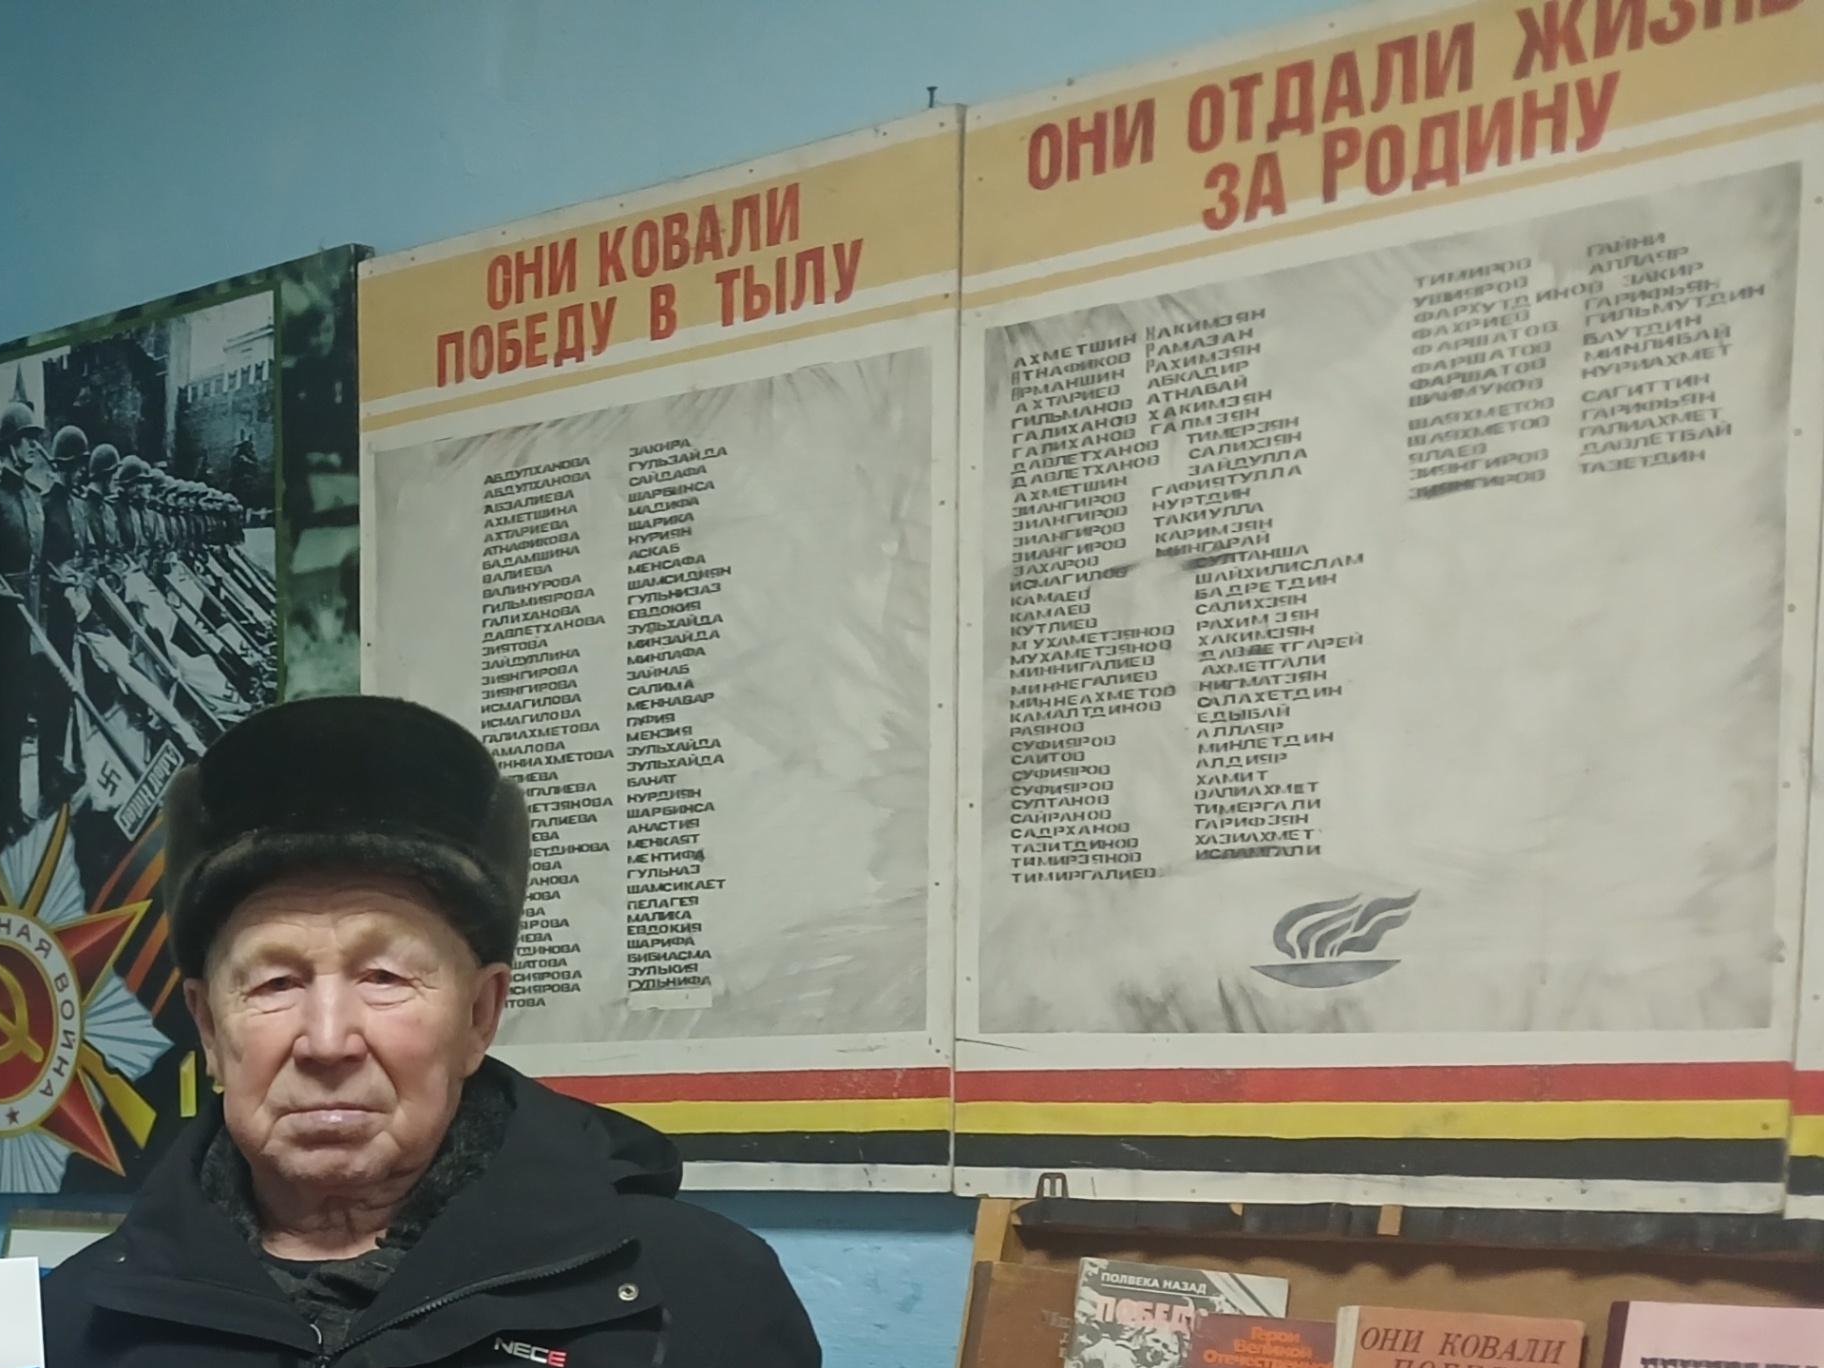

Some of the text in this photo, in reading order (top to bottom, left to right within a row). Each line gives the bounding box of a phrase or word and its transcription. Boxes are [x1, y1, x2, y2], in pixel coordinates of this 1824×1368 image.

[1028, 0, 1806, 191] ОНИ ОТДАЛИ ЖИЗ
[1201, 71, 1621, 231] ЗА РОДИНУ
[487, 182, 800, 311] ОНИ КОВАЛИ
[436, 238, 864, 388] ПОБЕДУ В ТЫЛУ
[1014, 333, 1137, 368] АХМЕТШИН
[1012, 398, 1133, 429] ГИЛЬМАНОВ
[1012, 413, 1136, 444] ГАЛИХАНОВ
[1012, 428, 1135, 459] ГАЛИХАНОВ
[484, 457, 590, 484] АБДУЛХАНОВА
[483, 471, 591, 499] АБДУЛХАНОВА
[1014, 476, 1127, 503] АХМЕТШИН
[483, 489, 574, 514] АБЗАЛИЕВА
[484, 504, 578, 528] АХМЕТШИНА
[483, 520, 569, 543] АХТАРИЕВА
[482, 543, 680, 584] ВАЛИЕВА АСКАБ
[482, 554, 706, 599] ВАЛИНУРОВА МЕНСАФА
[481, 693, 582, 714] ИСМАГИЛОВА
[481, 709, 581, 730] ИСМАГИЛОВА
[626, 864, 701, 880] ГУЛЬНАЗ
[627, 896, 699, 911] ПЕЛАГЕЯ
[627, 910, 692, 924] МАЛИКА
[627, 923, 702, 936] ЕВДОКИЯ
[627, 936, 696, 950] ШАРИФА
[1101, 1271, 1207, 1295] ПОЛВЕКА НАЗАД
[1096, 1296, 1195, 1338] ПОБЕД
[1360, 1327, 1566, 1365] ОНИ КОВАЛИ
